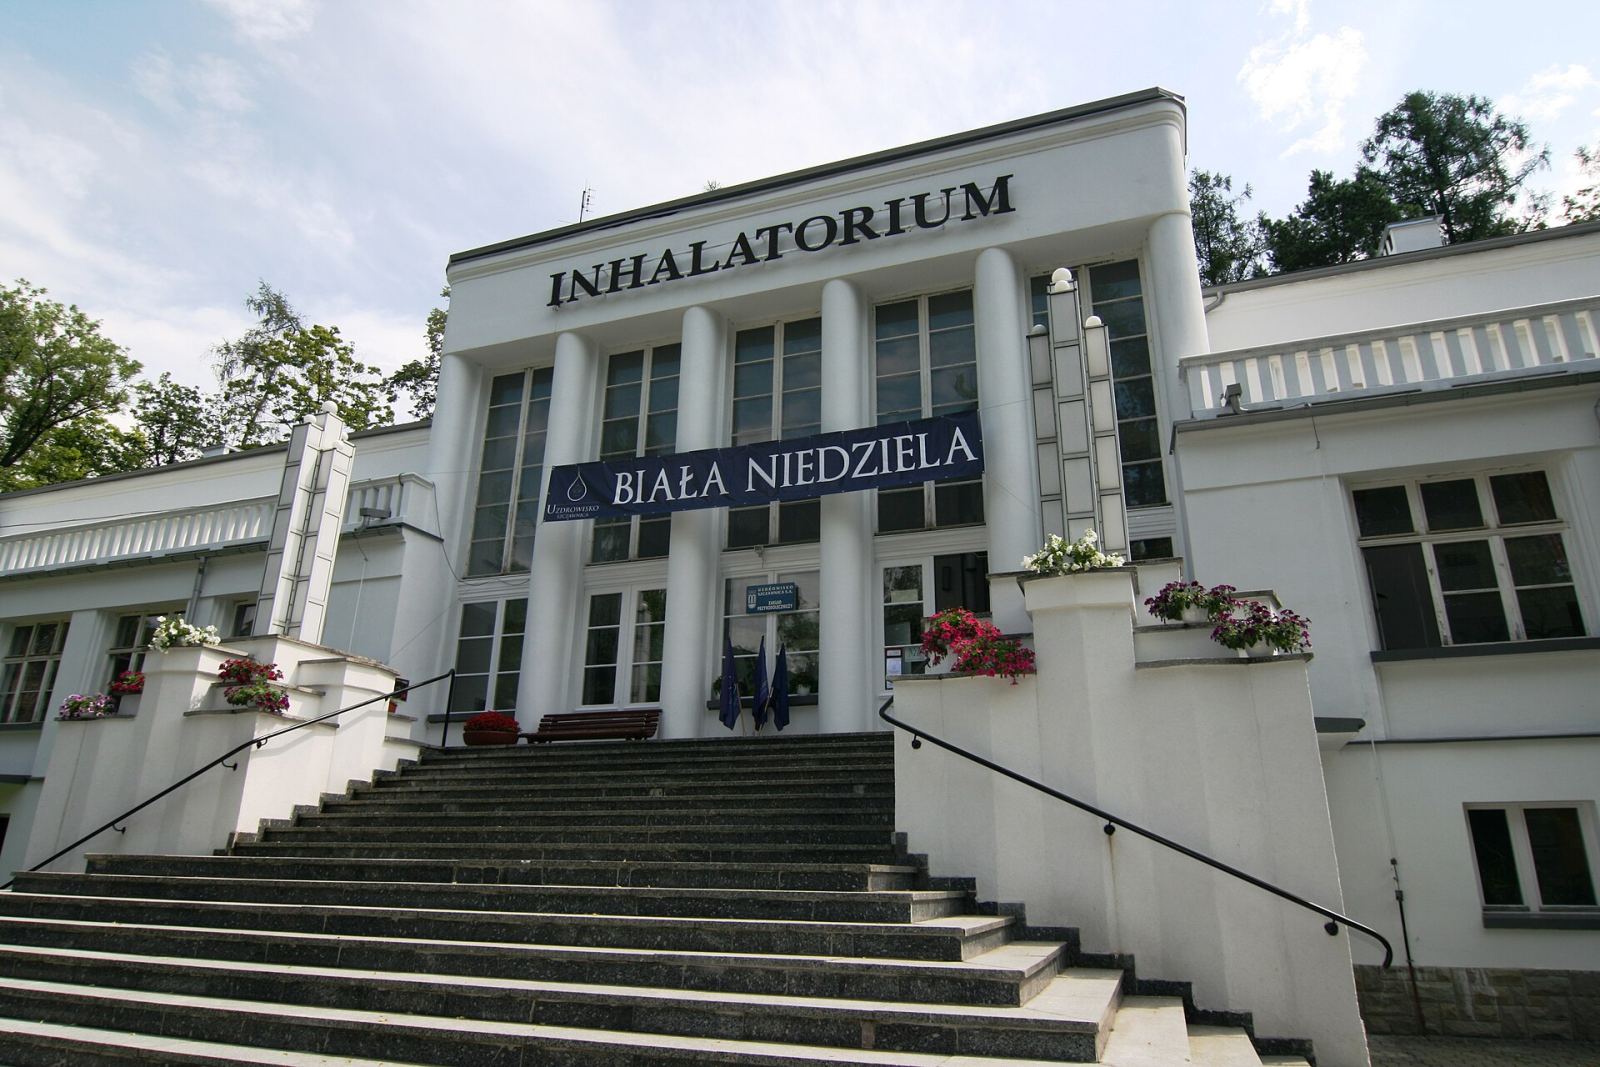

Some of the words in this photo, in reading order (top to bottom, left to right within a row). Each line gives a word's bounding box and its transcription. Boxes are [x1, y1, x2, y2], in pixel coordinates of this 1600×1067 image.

[546, 173, 1016, 308] INHALATORIUM
[611, 460, 730, 506] BIAŁA
[744, 426, 979, 493] NIEDZIELA
